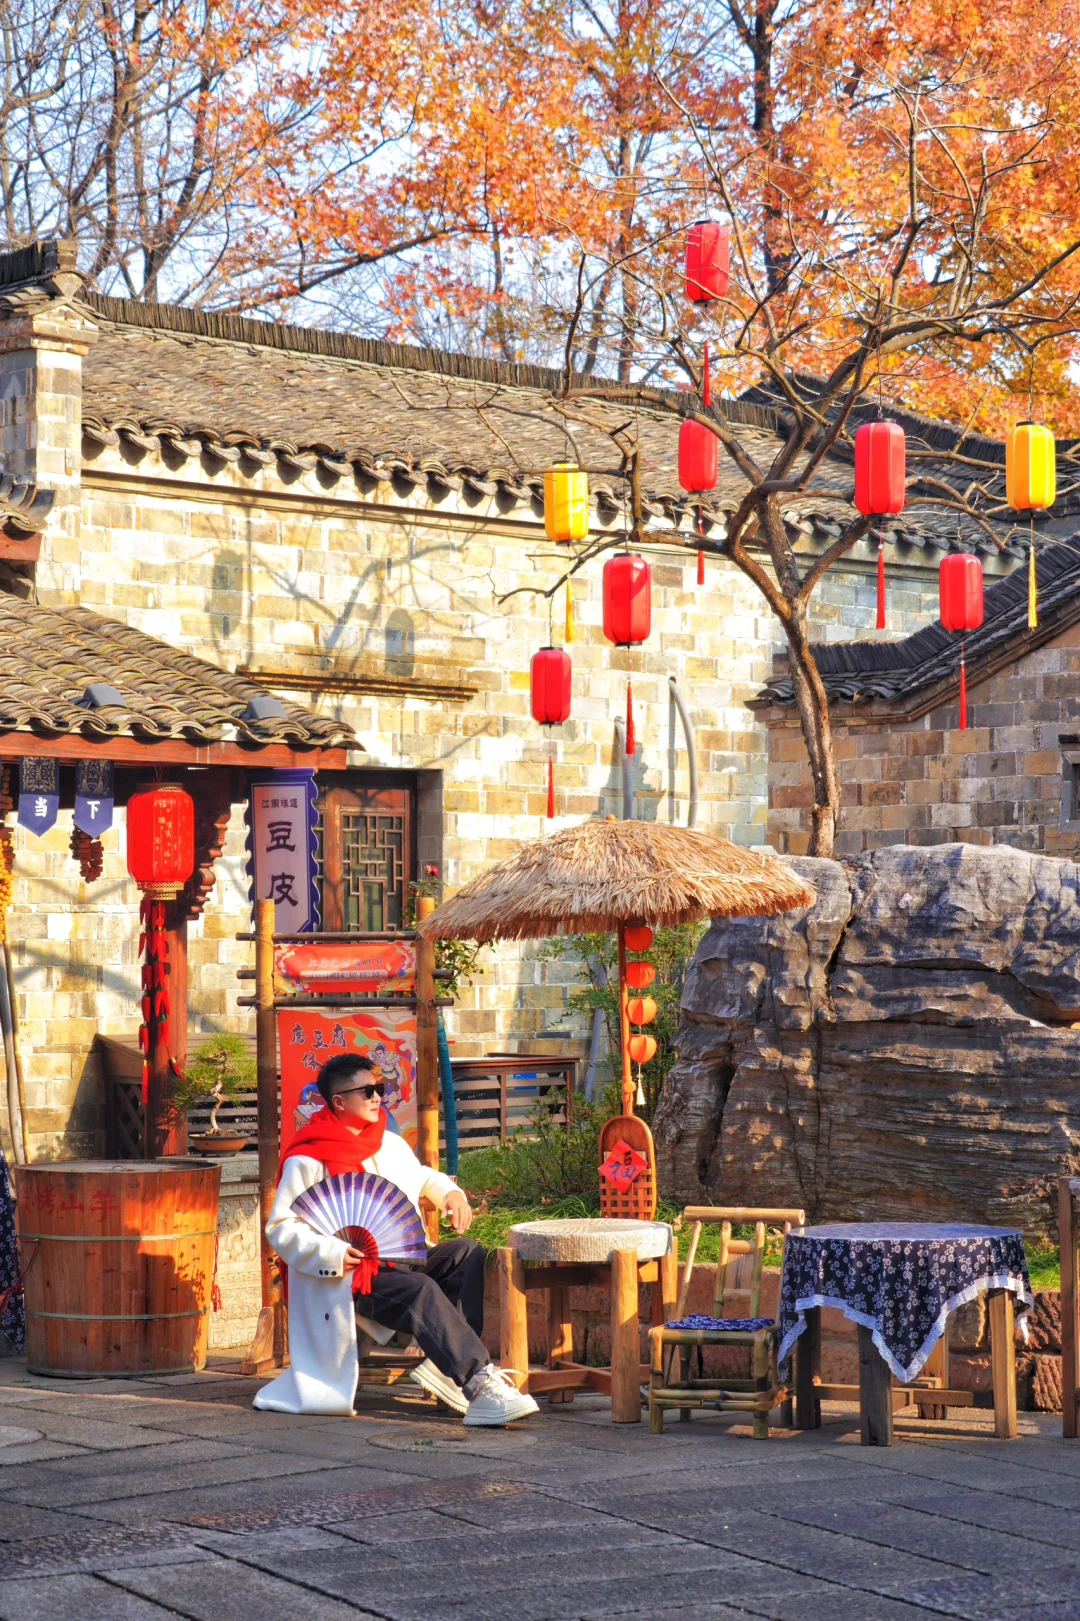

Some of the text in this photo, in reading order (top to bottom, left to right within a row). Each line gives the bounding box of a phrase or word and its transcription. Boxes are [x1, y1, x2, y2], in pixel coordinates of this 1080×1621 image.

[35, 797, 48, 818] 当
[87, 801, 101, 820] 下
[265, 820, 299, 907] 豆皮
[290, 1023, 348, 1049] 磨豆腐
[609, 1151, 637, 1181] 福
